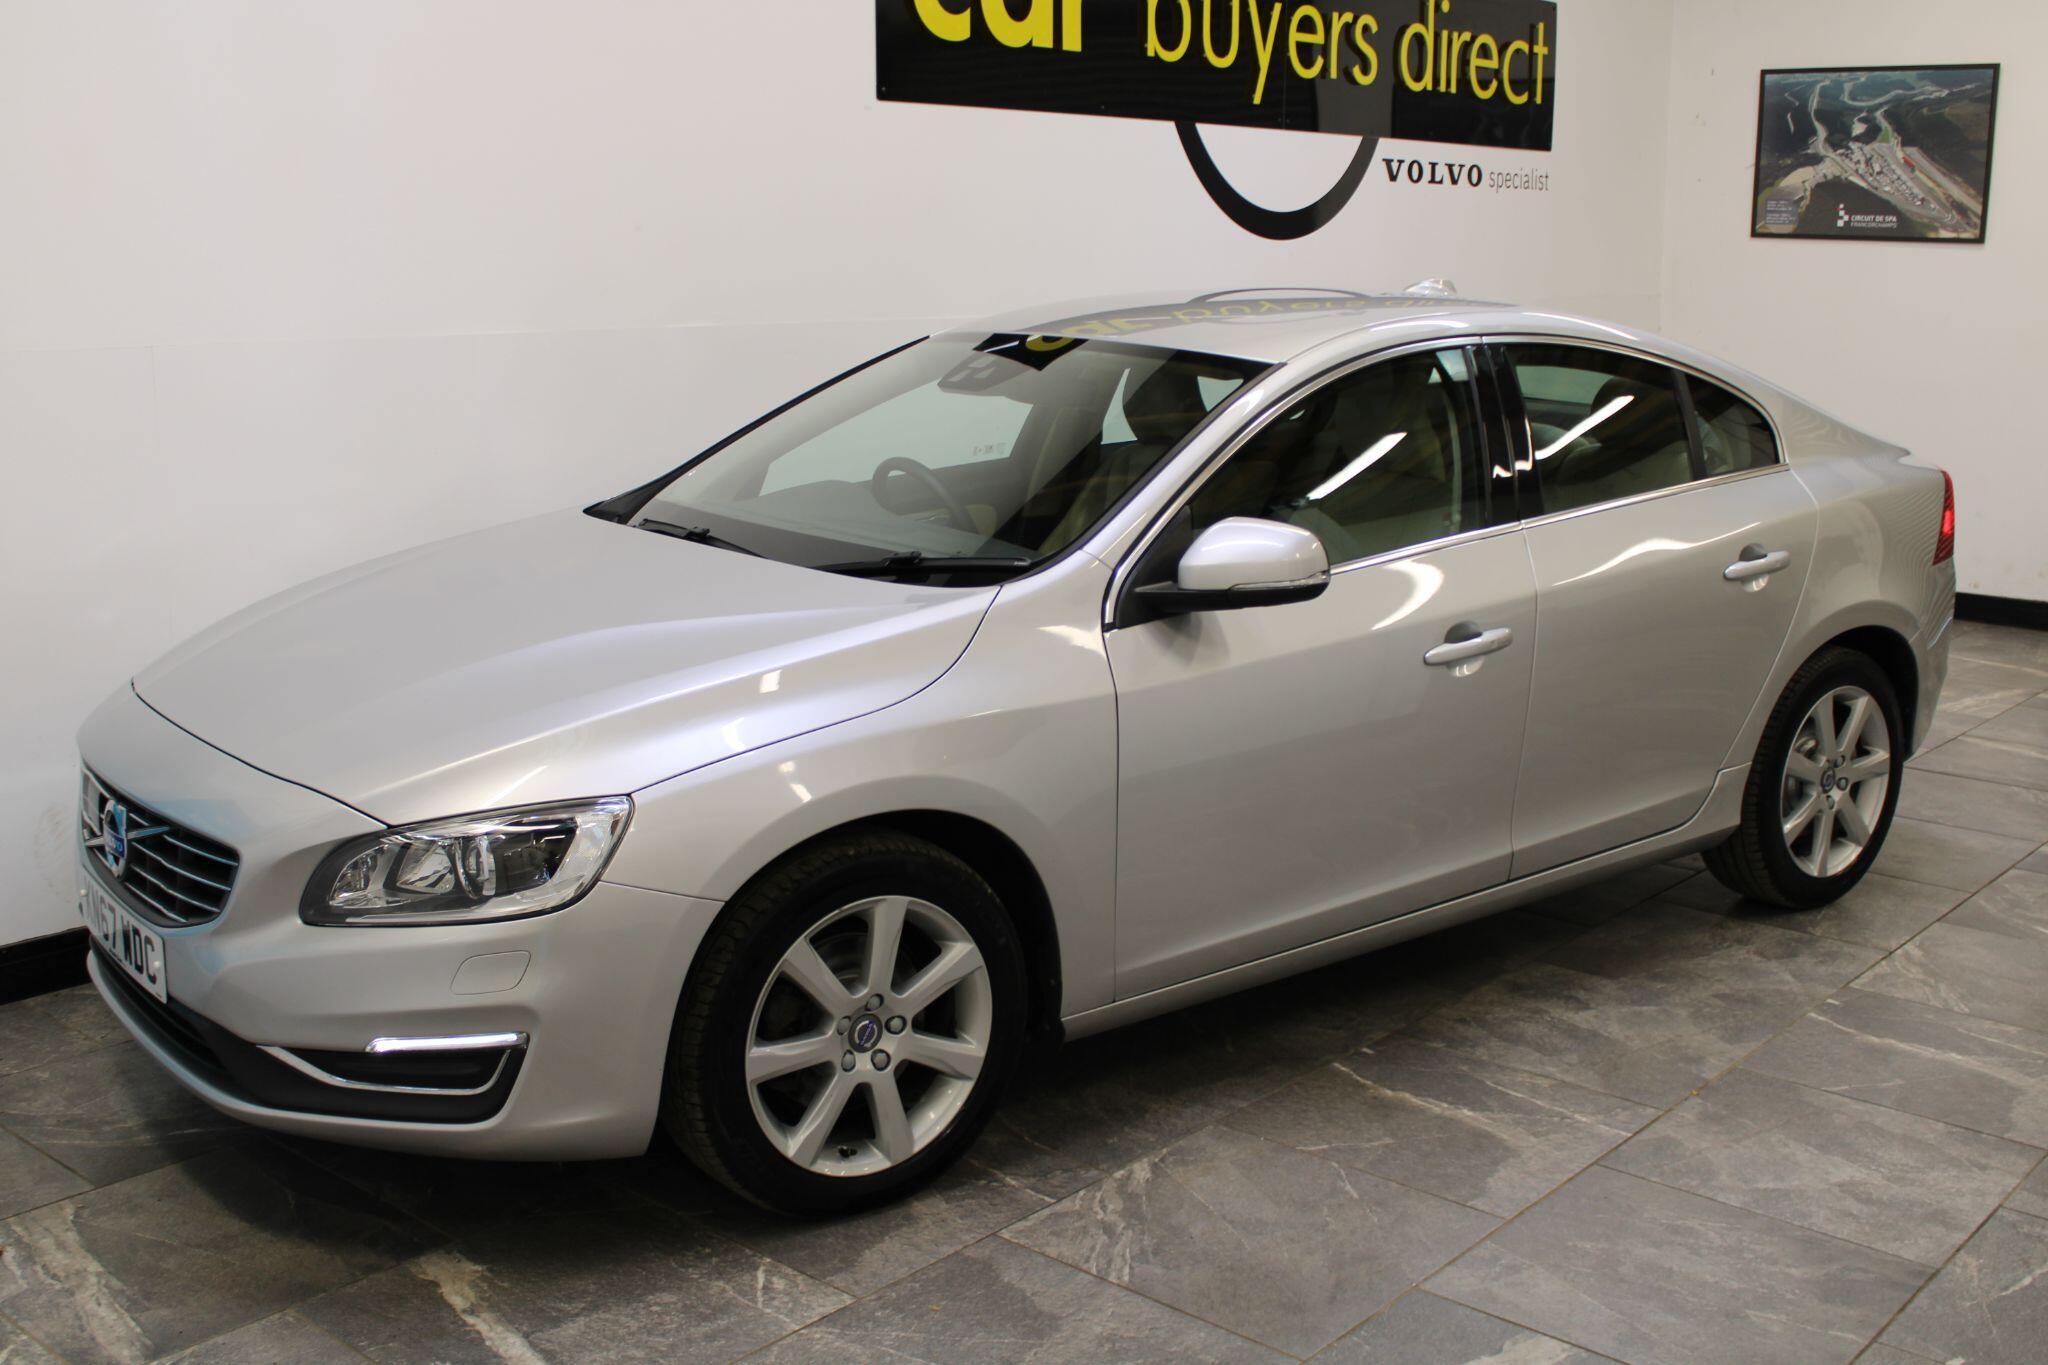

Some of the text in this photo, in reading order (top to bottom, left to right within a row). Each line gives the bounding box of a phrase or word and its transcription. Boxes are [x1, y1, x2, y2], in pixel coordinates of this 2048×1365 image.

[1147, 0, 1378, 104] buyers
[1400, 0, 1548, 104] direct
[1382, 158, 1549, 193] VOLVO specialist
